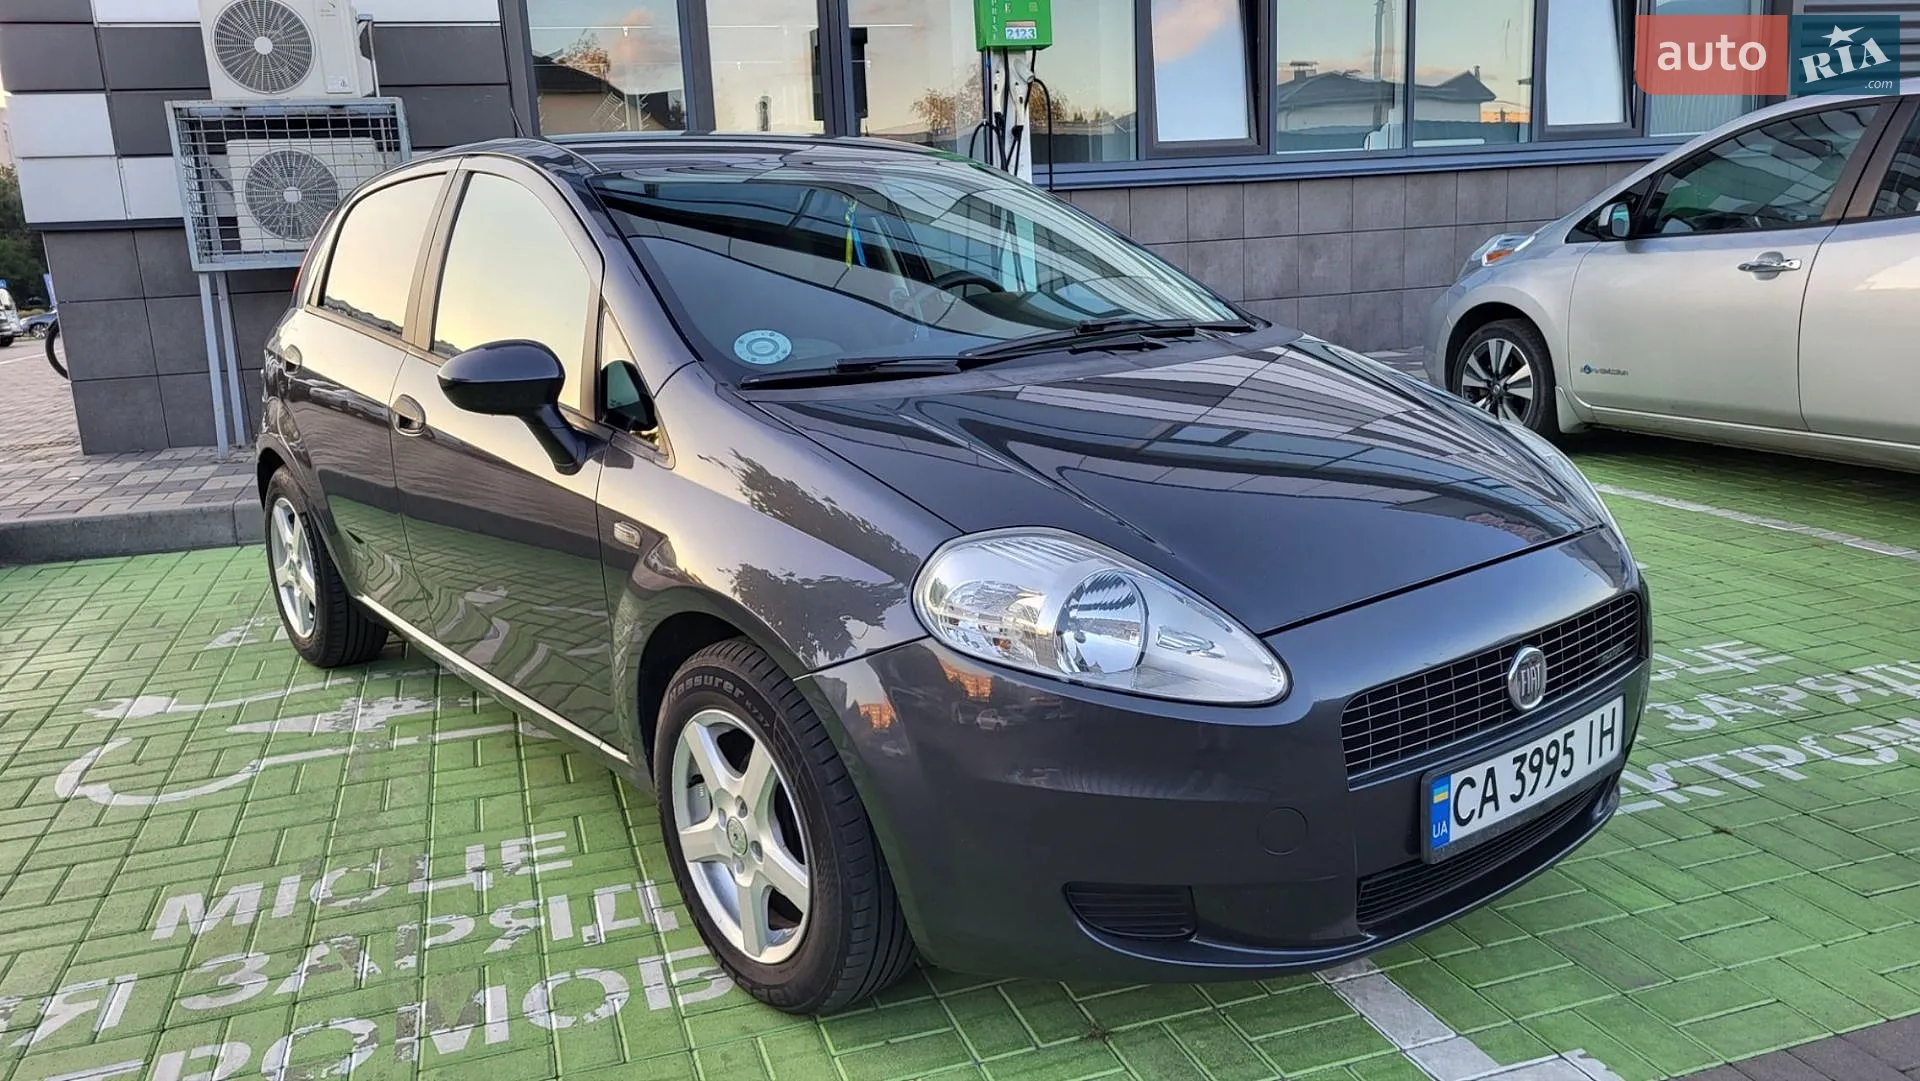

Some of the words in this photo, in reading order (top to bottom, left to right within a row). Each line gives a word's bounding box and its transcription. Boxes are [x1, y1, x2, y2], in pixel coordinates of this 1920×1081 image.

[1521, 664, 1541, 697] FIAT
[1453, 767, 1499, 827] CA
[1510, 729, 1575, 803] 3995
[1588, 707, 1615, 765] IH
[1433, 820, 1448, 838] UA
